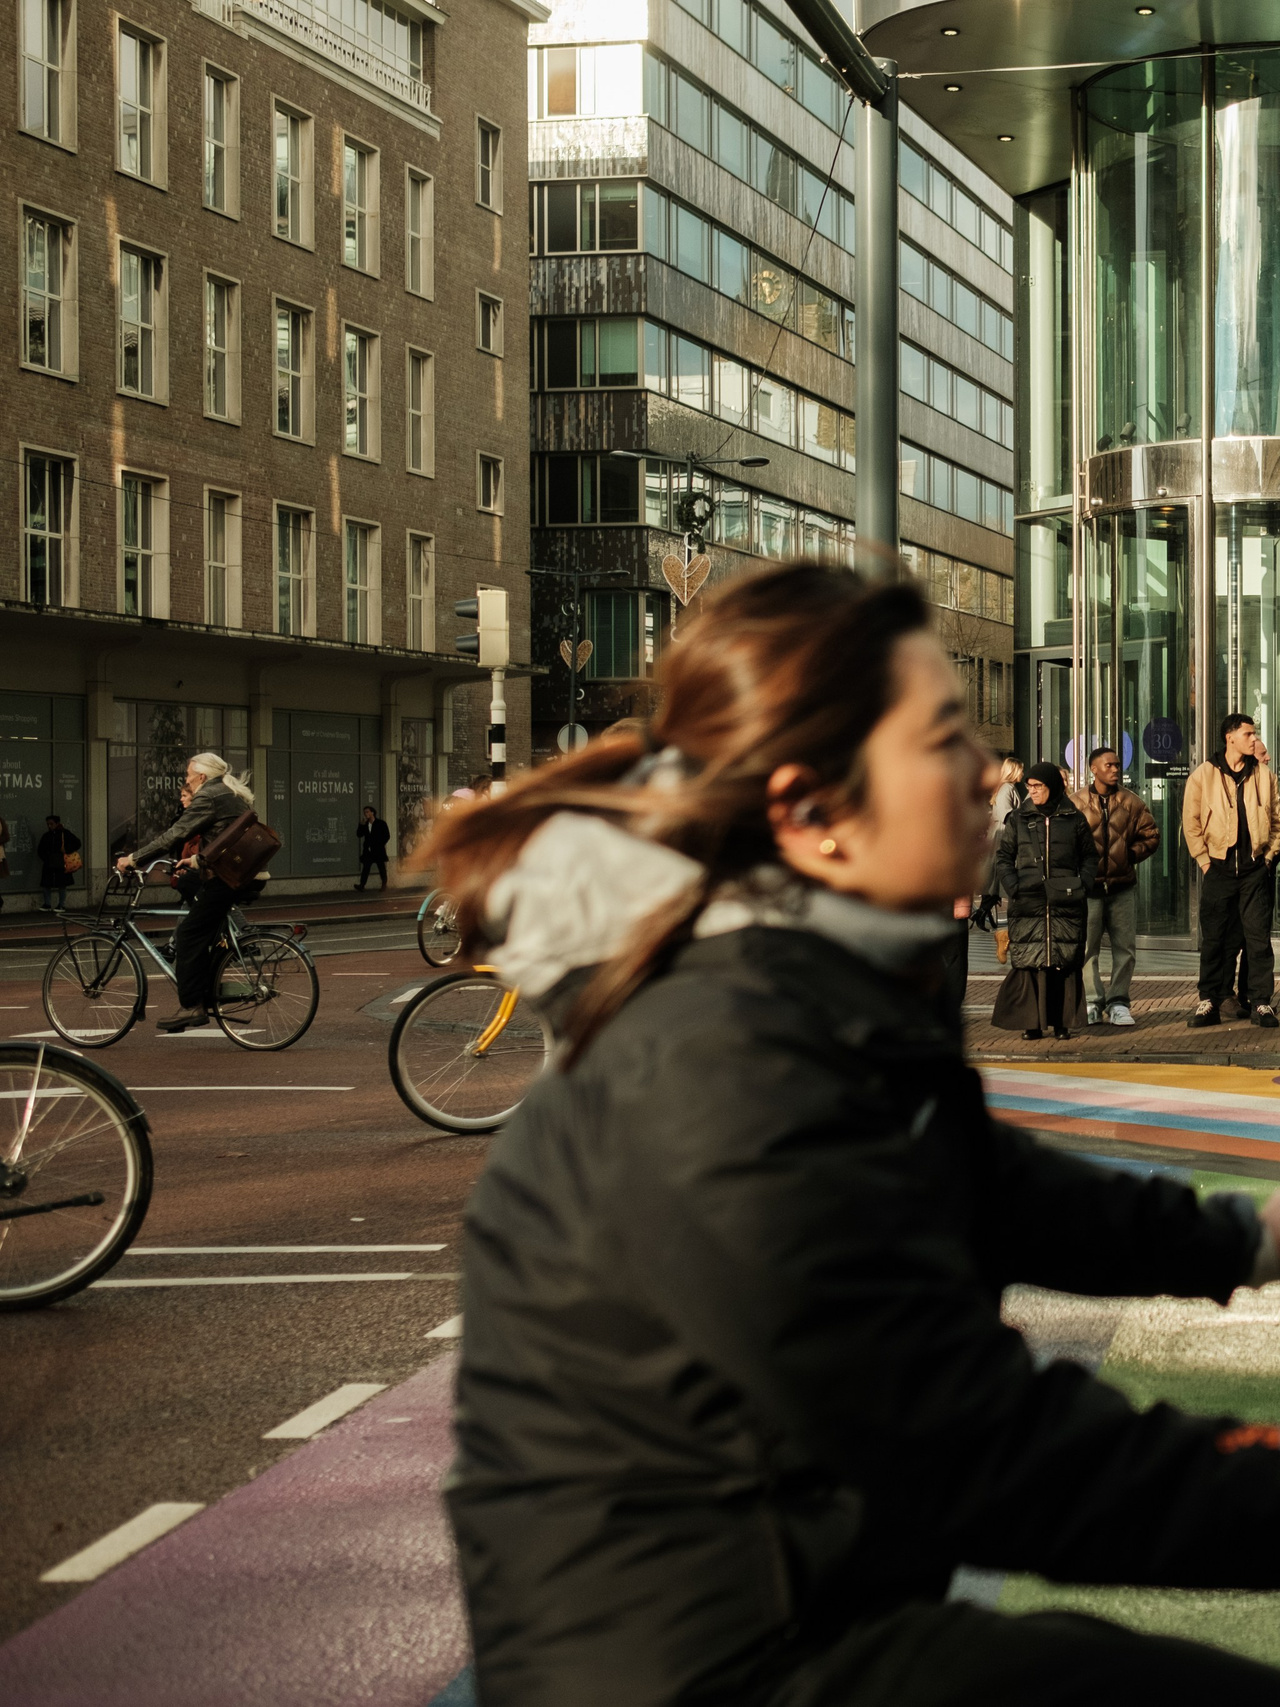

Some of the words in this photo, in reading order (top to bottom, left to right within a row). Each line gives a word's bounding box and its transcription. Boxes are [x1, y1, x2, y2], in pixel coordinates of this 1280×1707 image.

[1153, 734, 1172, 749] 30
[147, 776, 187, 790] CHRIS
[298, 781, 354, 794] CHRISTMAS
[400, 784, 431, 792] CHRISTMAS
